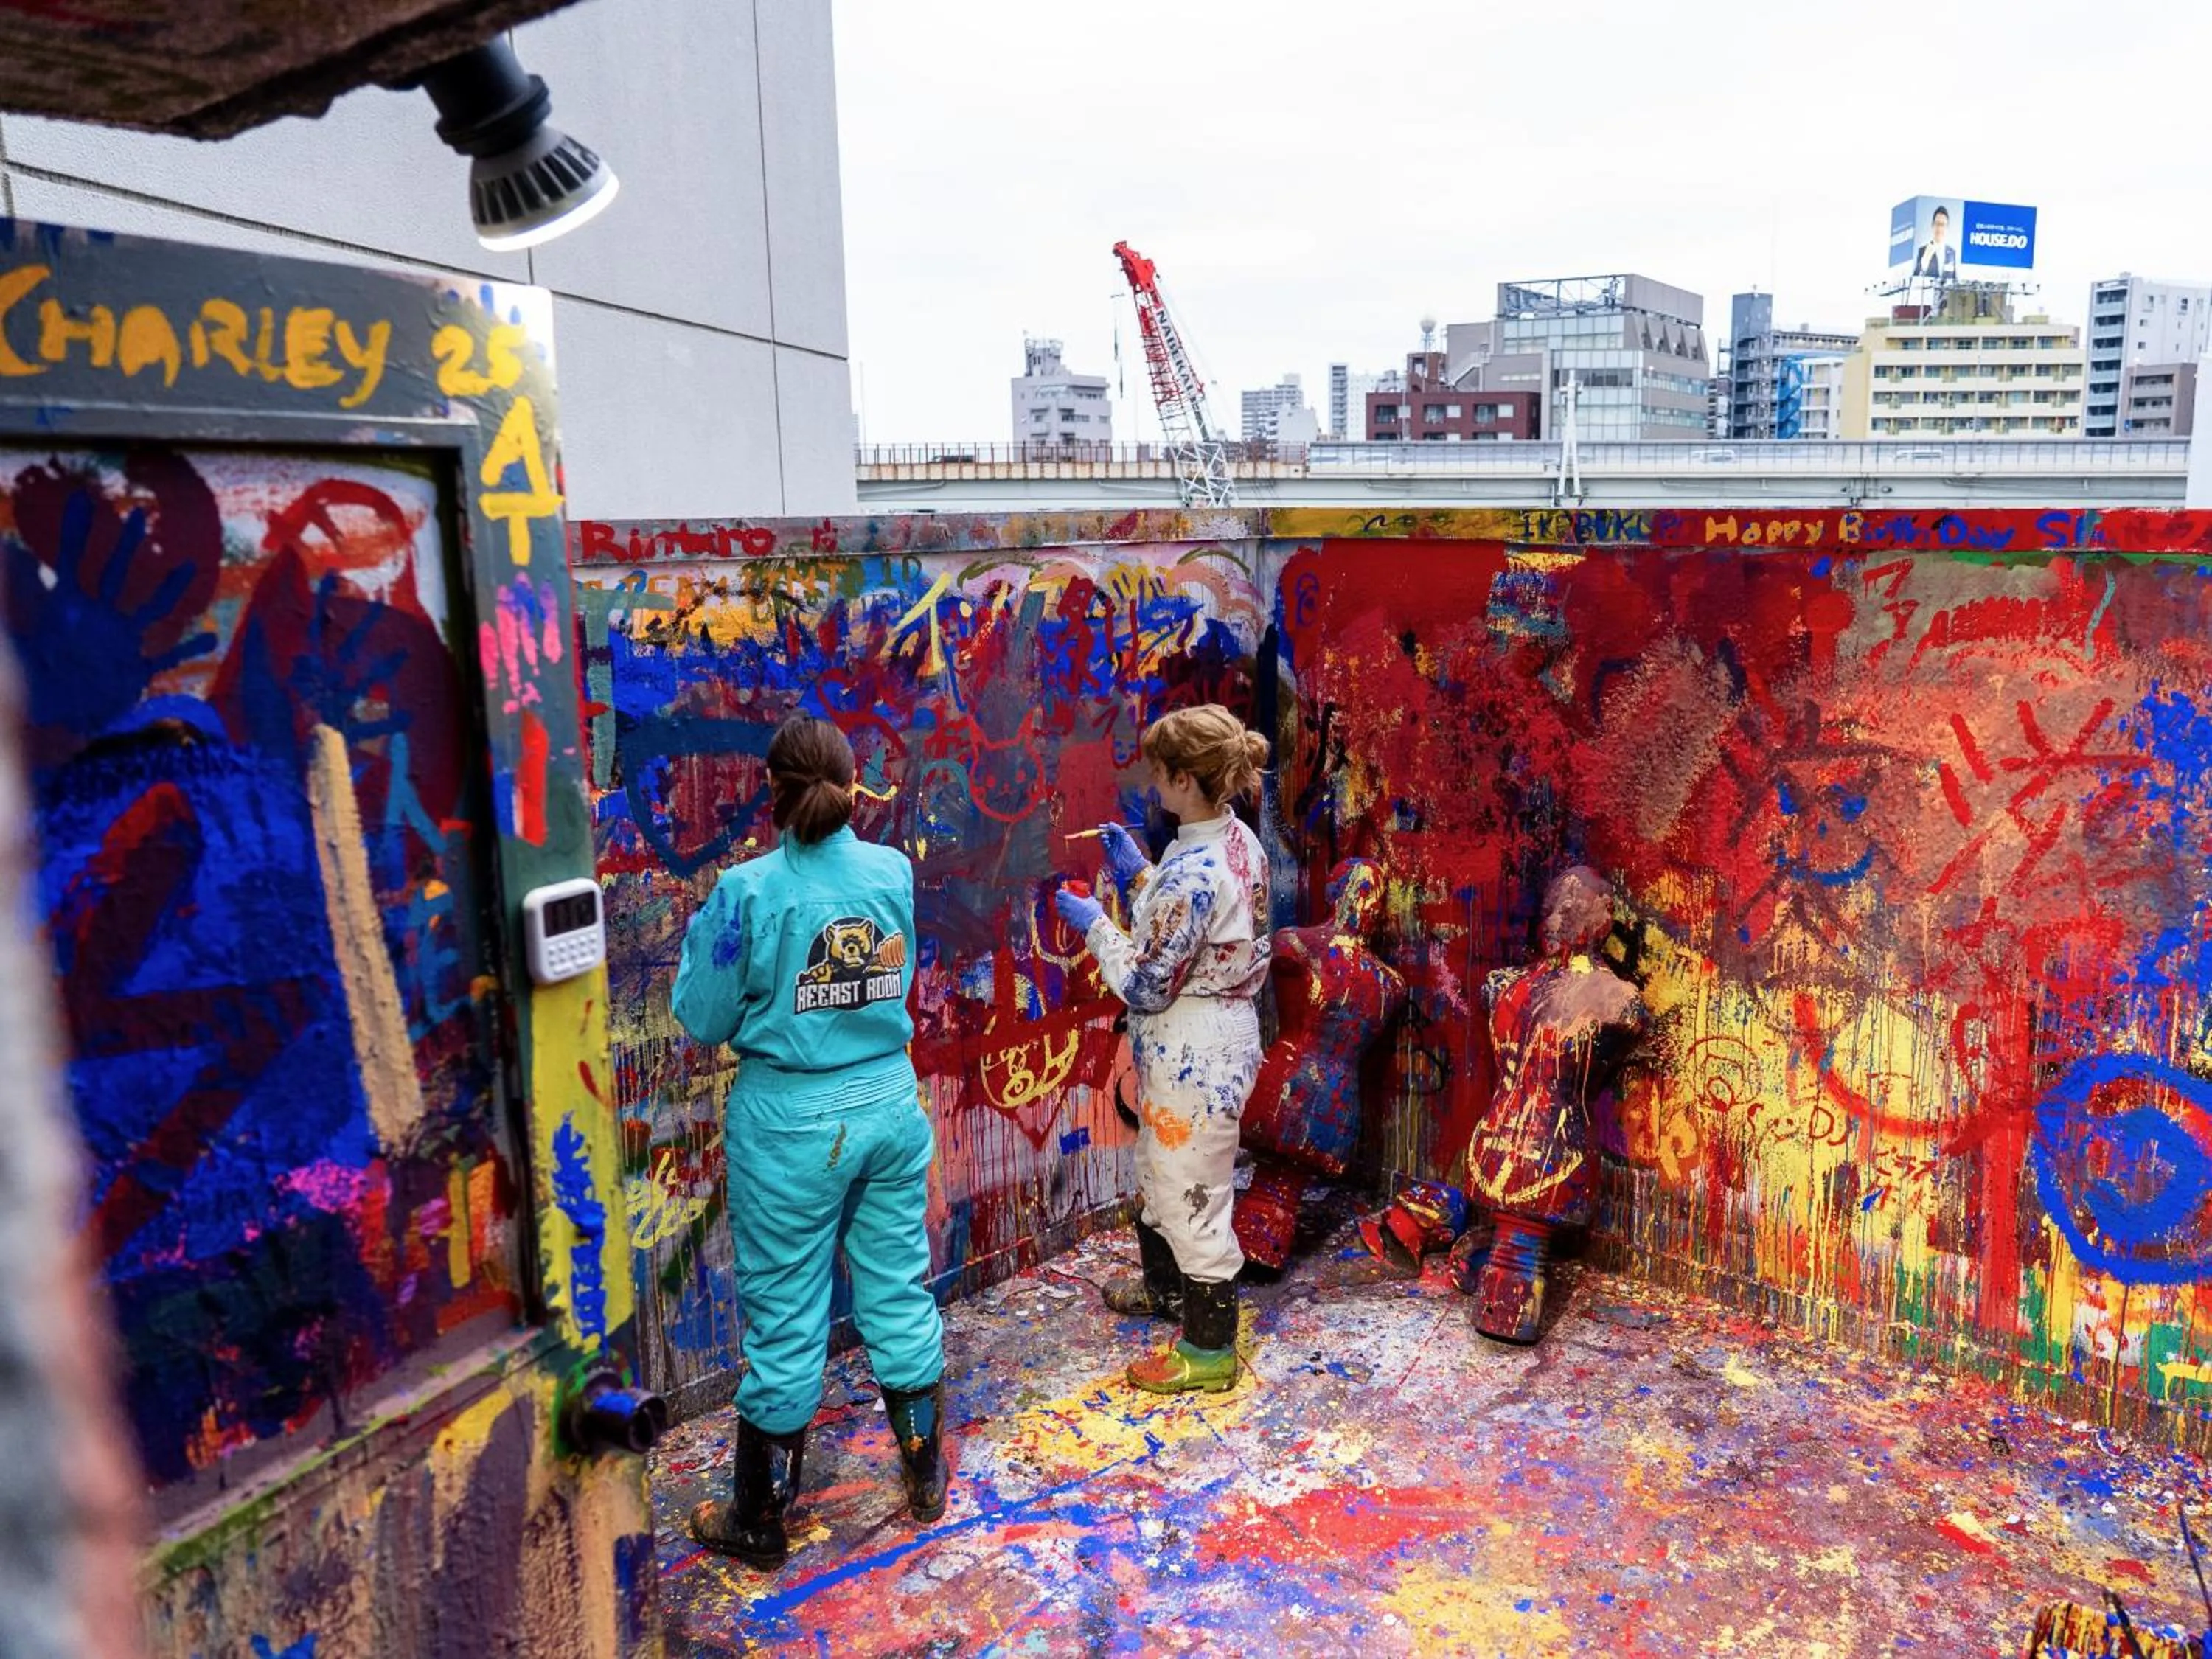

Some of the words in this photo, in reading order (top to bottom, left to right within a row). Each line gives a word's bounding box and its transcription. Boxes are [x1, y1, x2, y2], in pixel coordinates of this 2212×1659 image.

[0, 265, 389, 408] CHARLEY
[432, 323, 526, 397] 25
[1705, 514, 1825, 546] Happy
[866, 973, 901, 1001] ROOM
